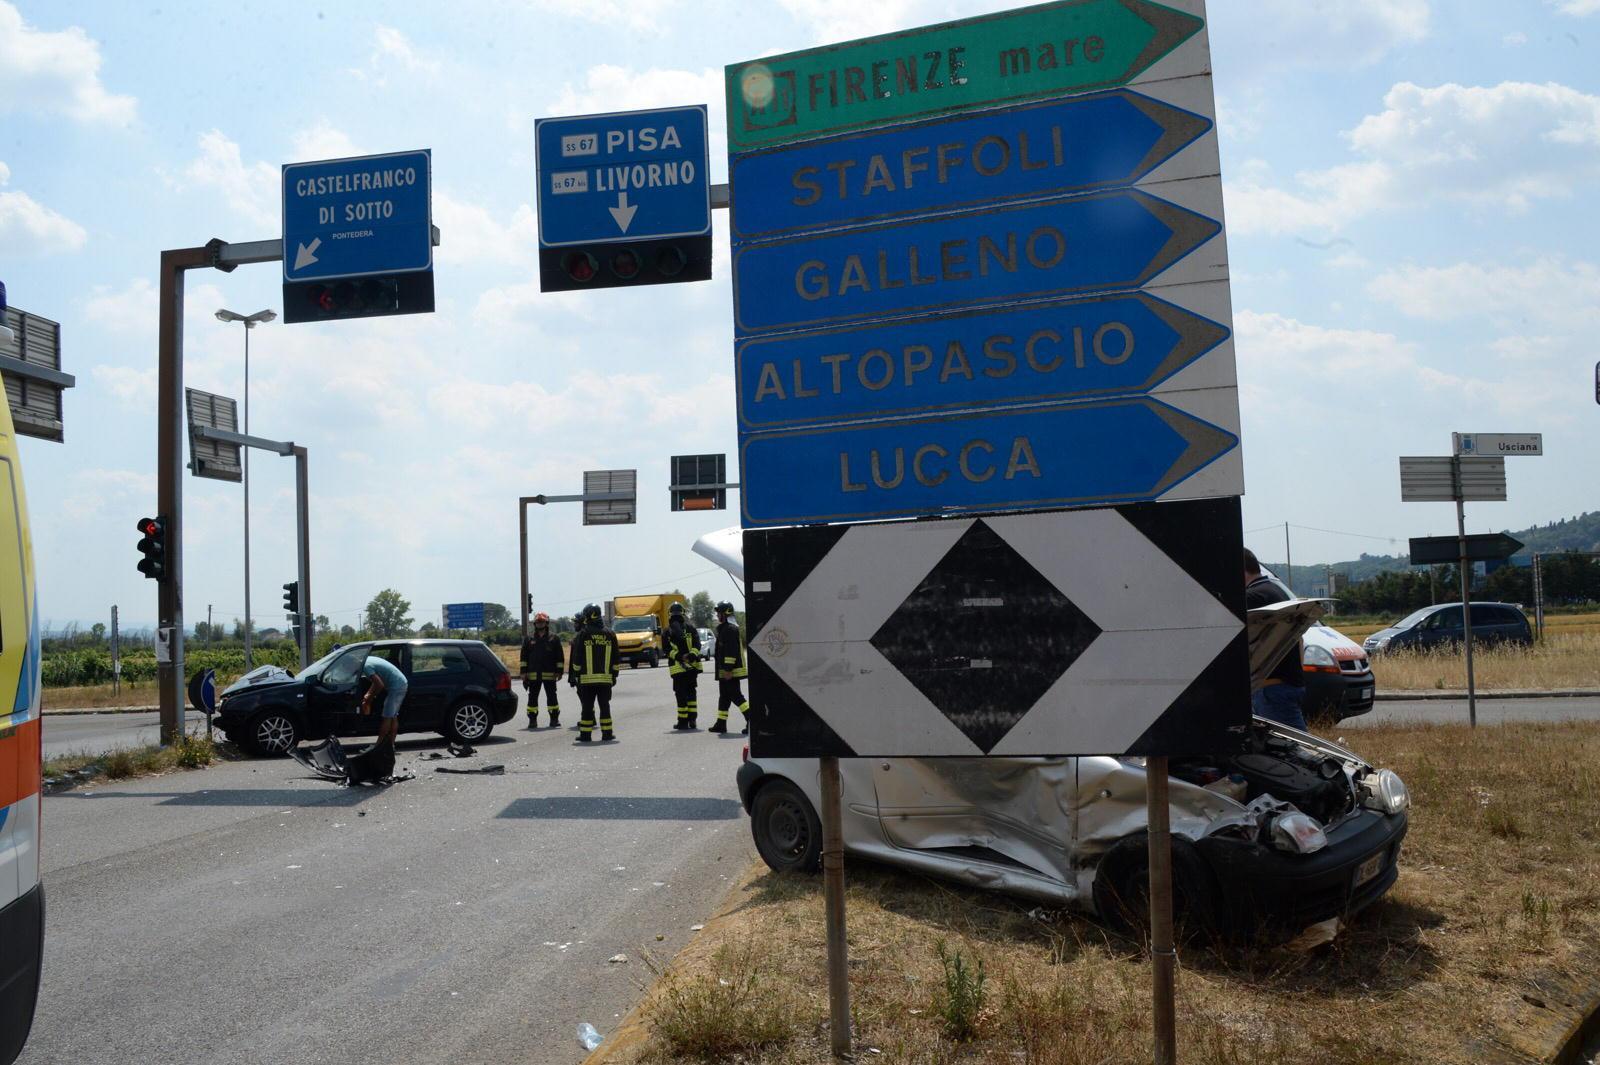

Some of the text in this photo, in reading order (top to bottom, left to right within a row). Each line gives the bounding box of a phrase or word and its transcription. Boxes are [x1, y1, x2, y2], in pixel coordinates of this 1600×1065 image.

[807, 47, 968, 112] FIRENZE
[999, 35, 1106, 78] mare
[579, 138, 594, 151] 67
[607, 125, 682, 154] PISA
[296, 167, 416, 197] CASTELFRANCO
[564, 177, 576, 188] 67
[596, 160, 695, 192] LIVORNO
[791, 126, 1065, 207] STAFFOLI
[319, 200, 393, 225] DI SOTTO
[332, 229, 374, 240] PONTEDERA
[794, 226, 1067, 301] GALLENO
[754, 321, 1136, 403] ALTOPASCIO
[1498, 442, 1538, 451] Usciana
[839, 436, 1042, 493] LUCCA
